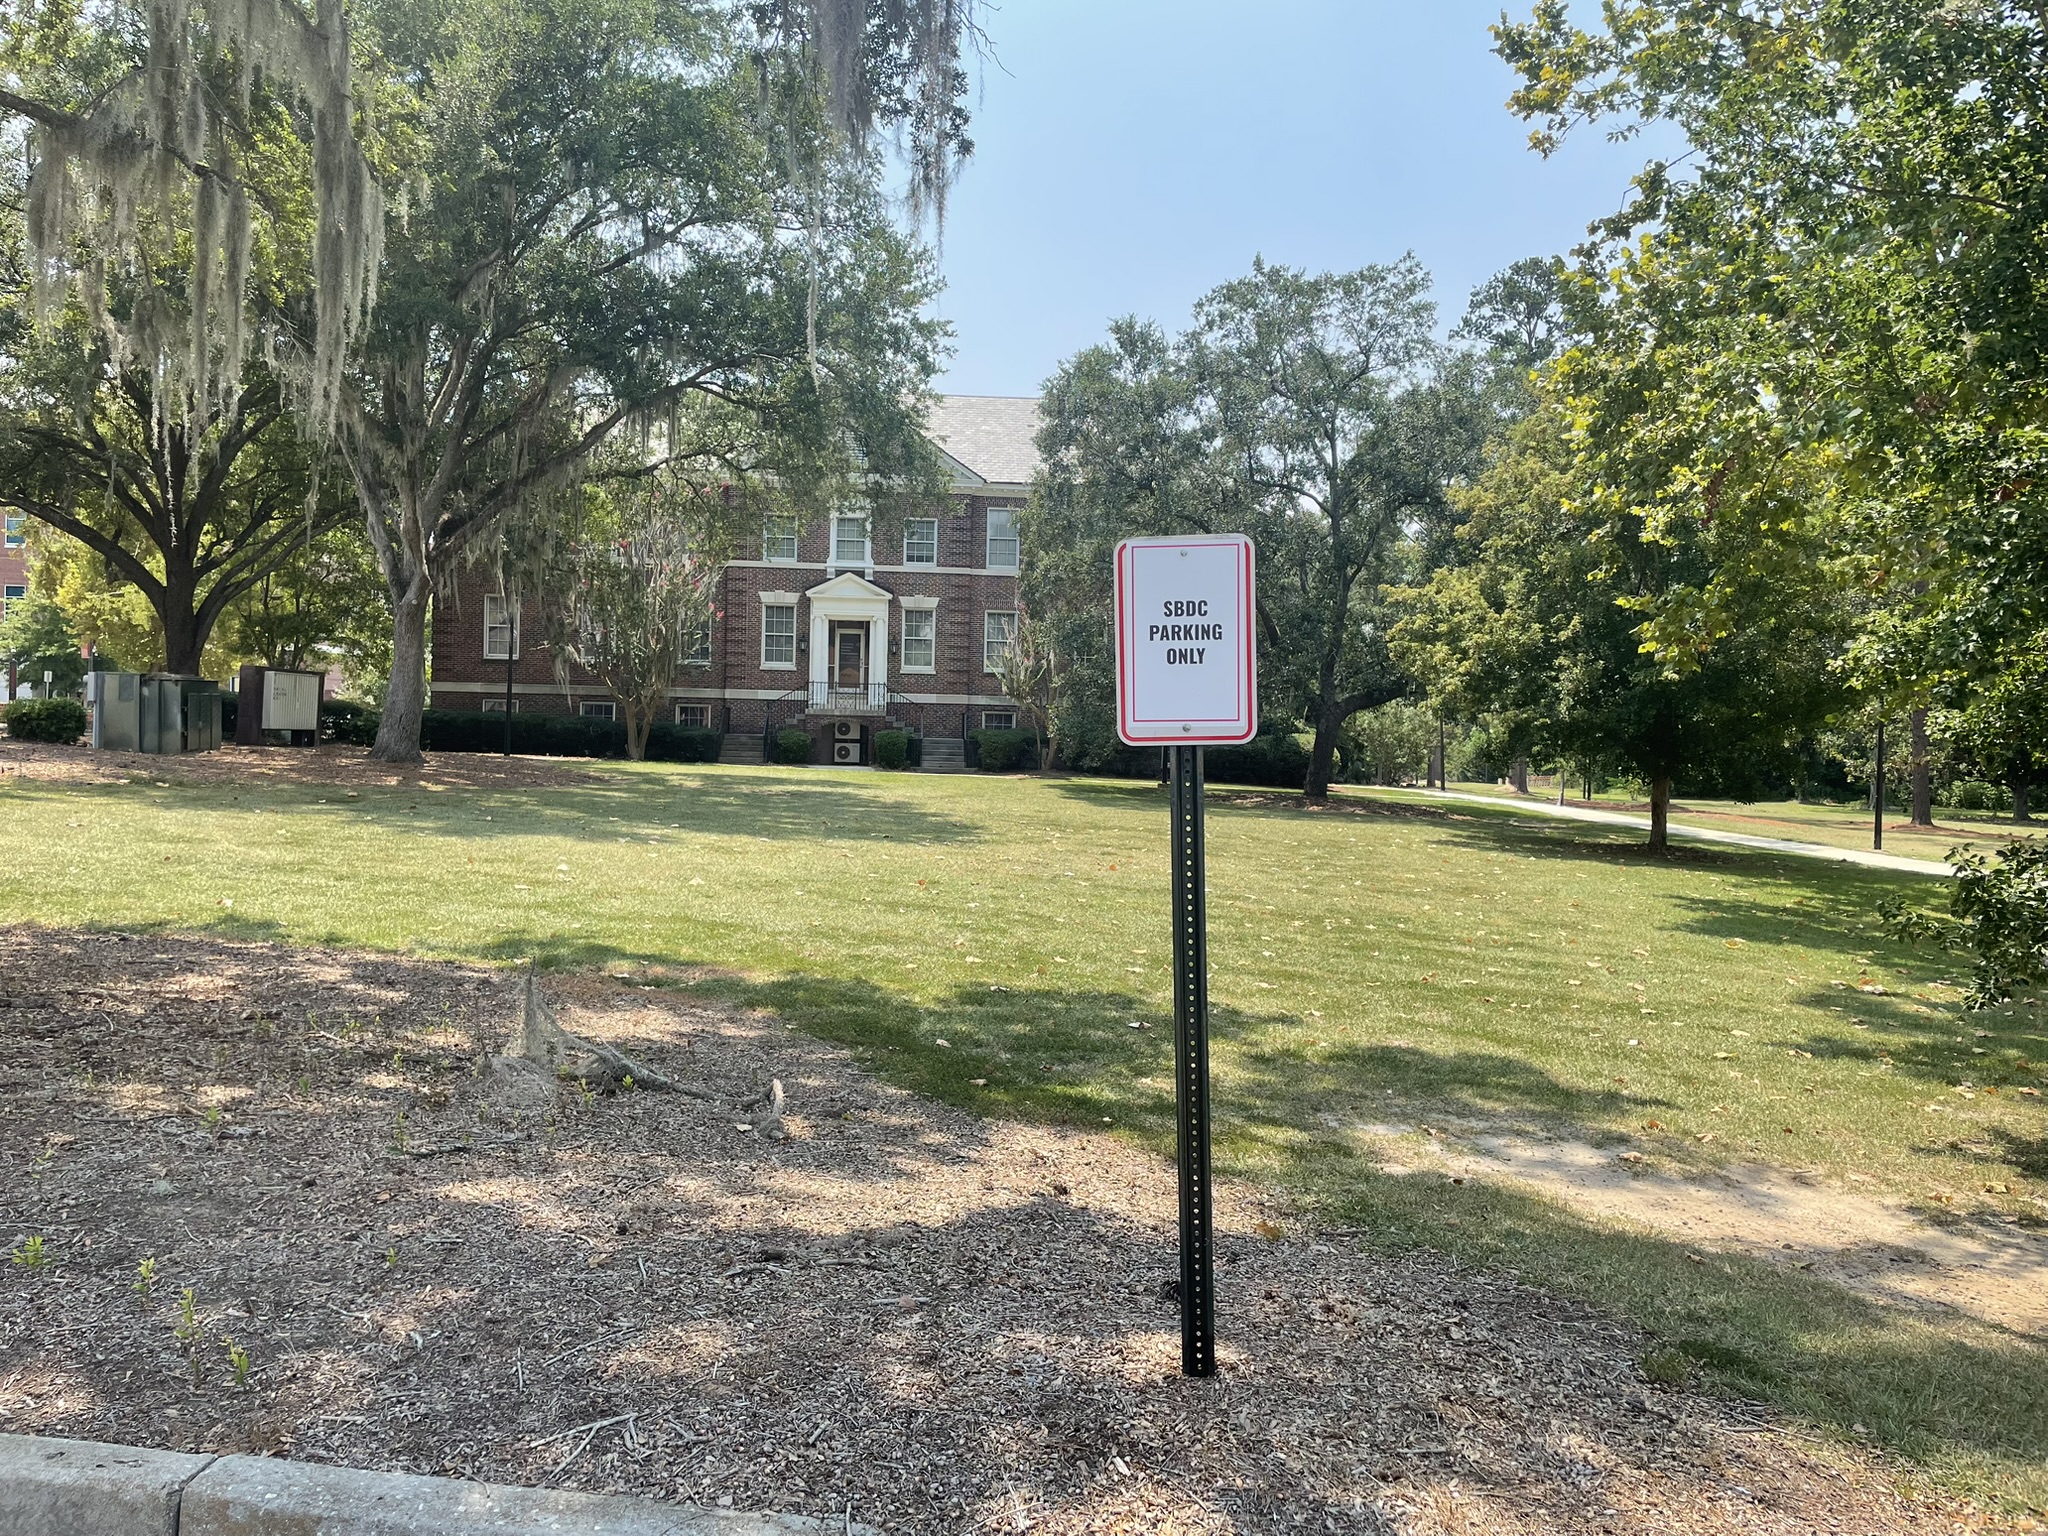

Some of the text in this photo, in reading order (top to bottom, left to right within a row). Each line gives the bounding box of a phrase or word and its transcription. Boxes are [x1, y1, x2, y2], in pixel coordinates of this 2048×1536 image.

[1163, 600, 1208, 617] SBDC
[1149, 624, 1223, 641] PARKING
[1166, 648, 1206, 665] ONLY
